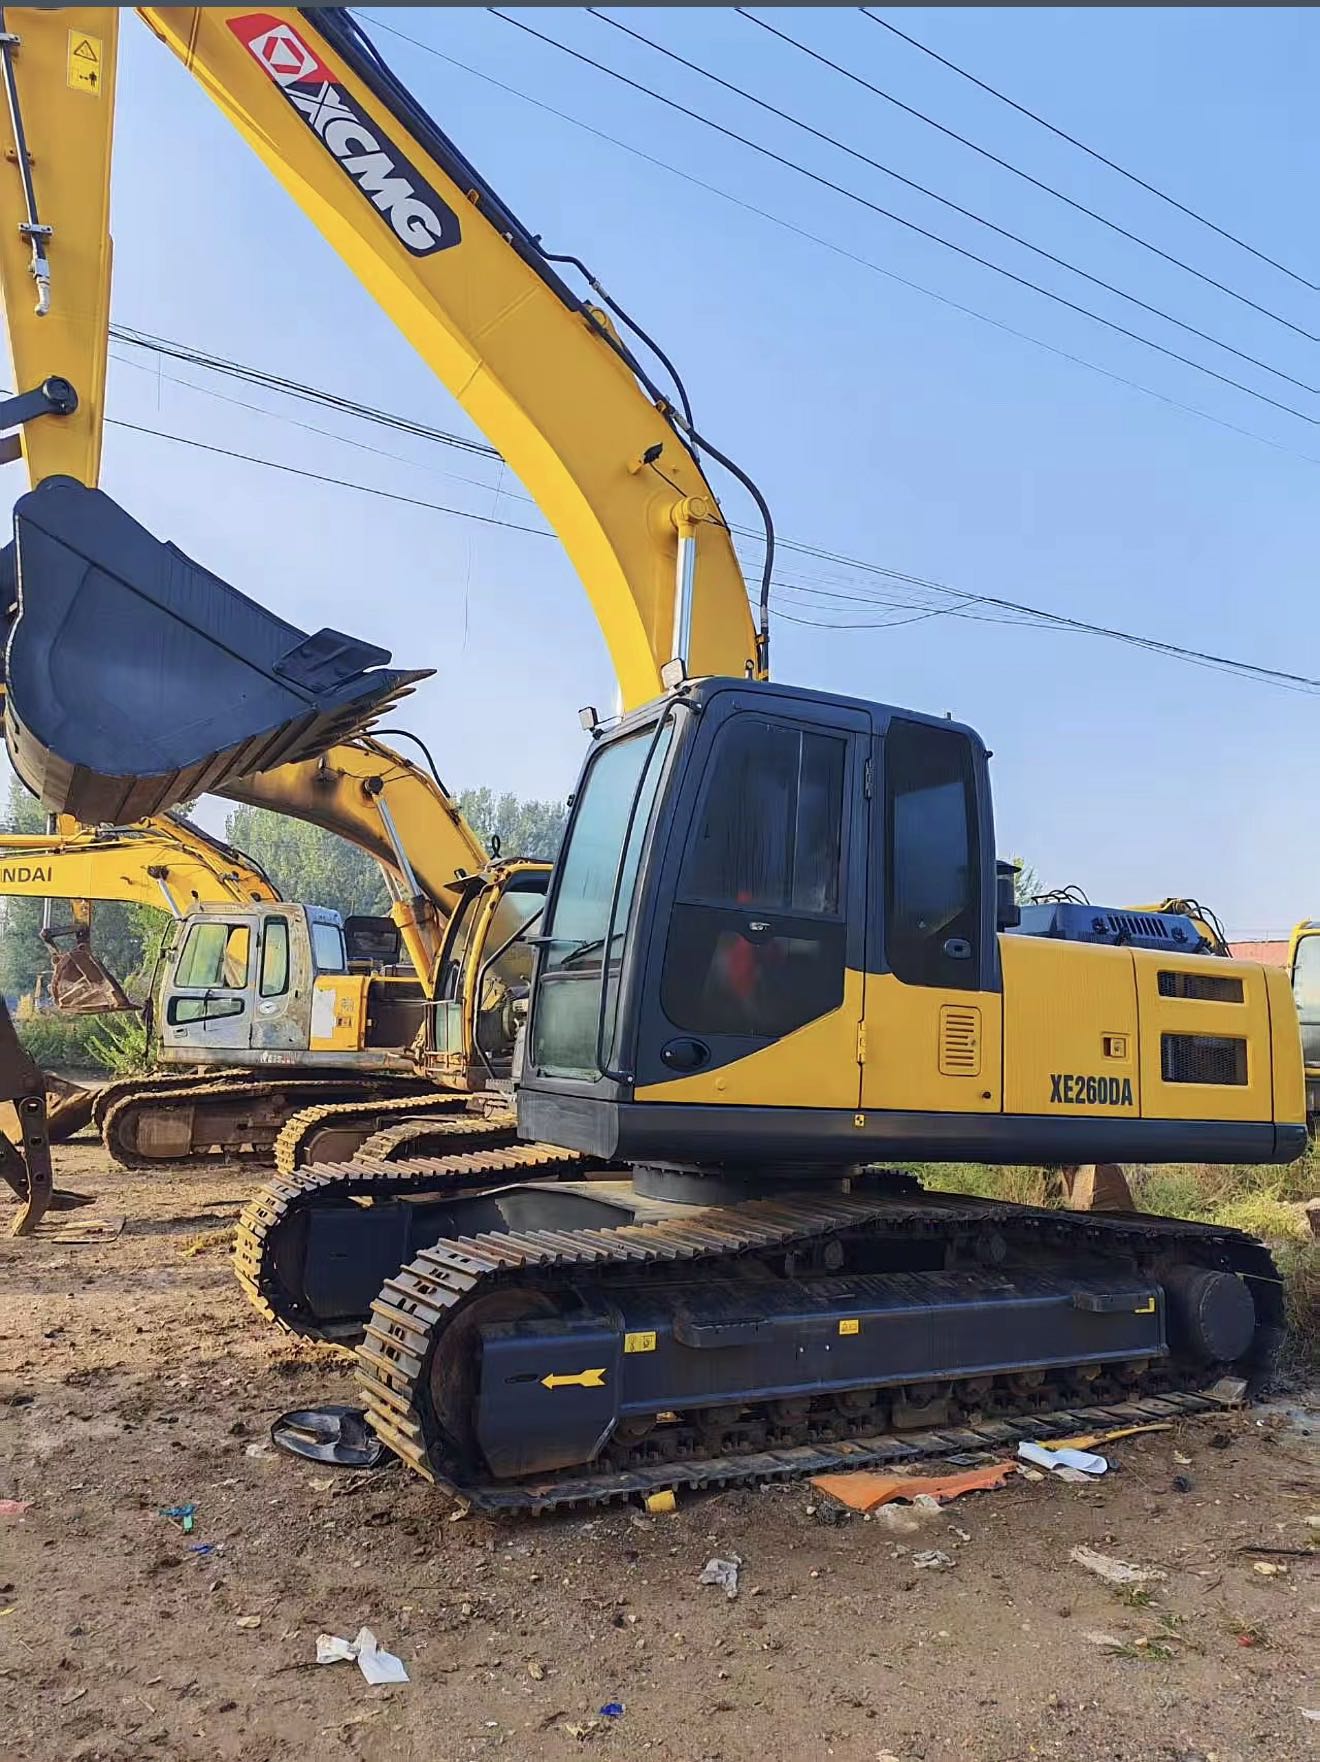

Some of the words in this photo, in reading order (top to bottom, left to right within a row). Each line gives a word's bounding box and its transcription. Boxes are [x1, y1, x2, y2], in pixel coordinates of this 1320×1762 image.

[284, 80, 442, 250] XCMG
[0, 866, 52, 882] NDAI
[1050, 1074, 1133, 1106] XE260DA
